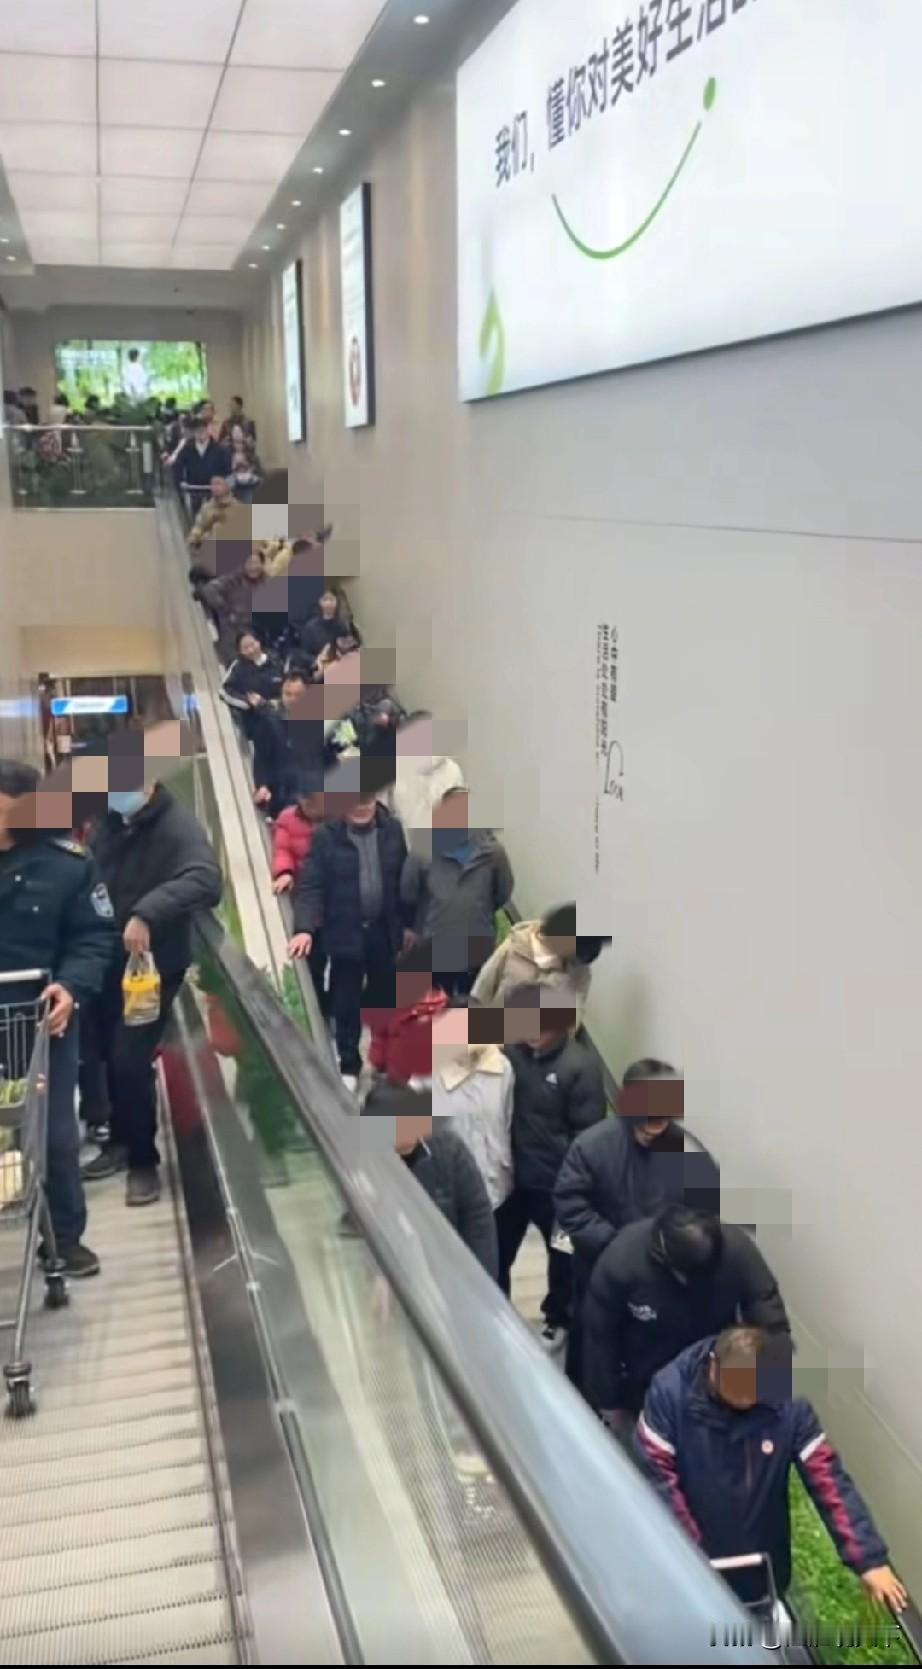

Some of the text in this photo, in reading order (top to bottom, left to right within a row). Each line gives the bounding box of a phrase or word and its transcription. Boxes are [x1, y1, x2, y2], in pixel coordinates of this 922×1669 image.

[495, 0, 756, 187] 我们，懂你对美好生
